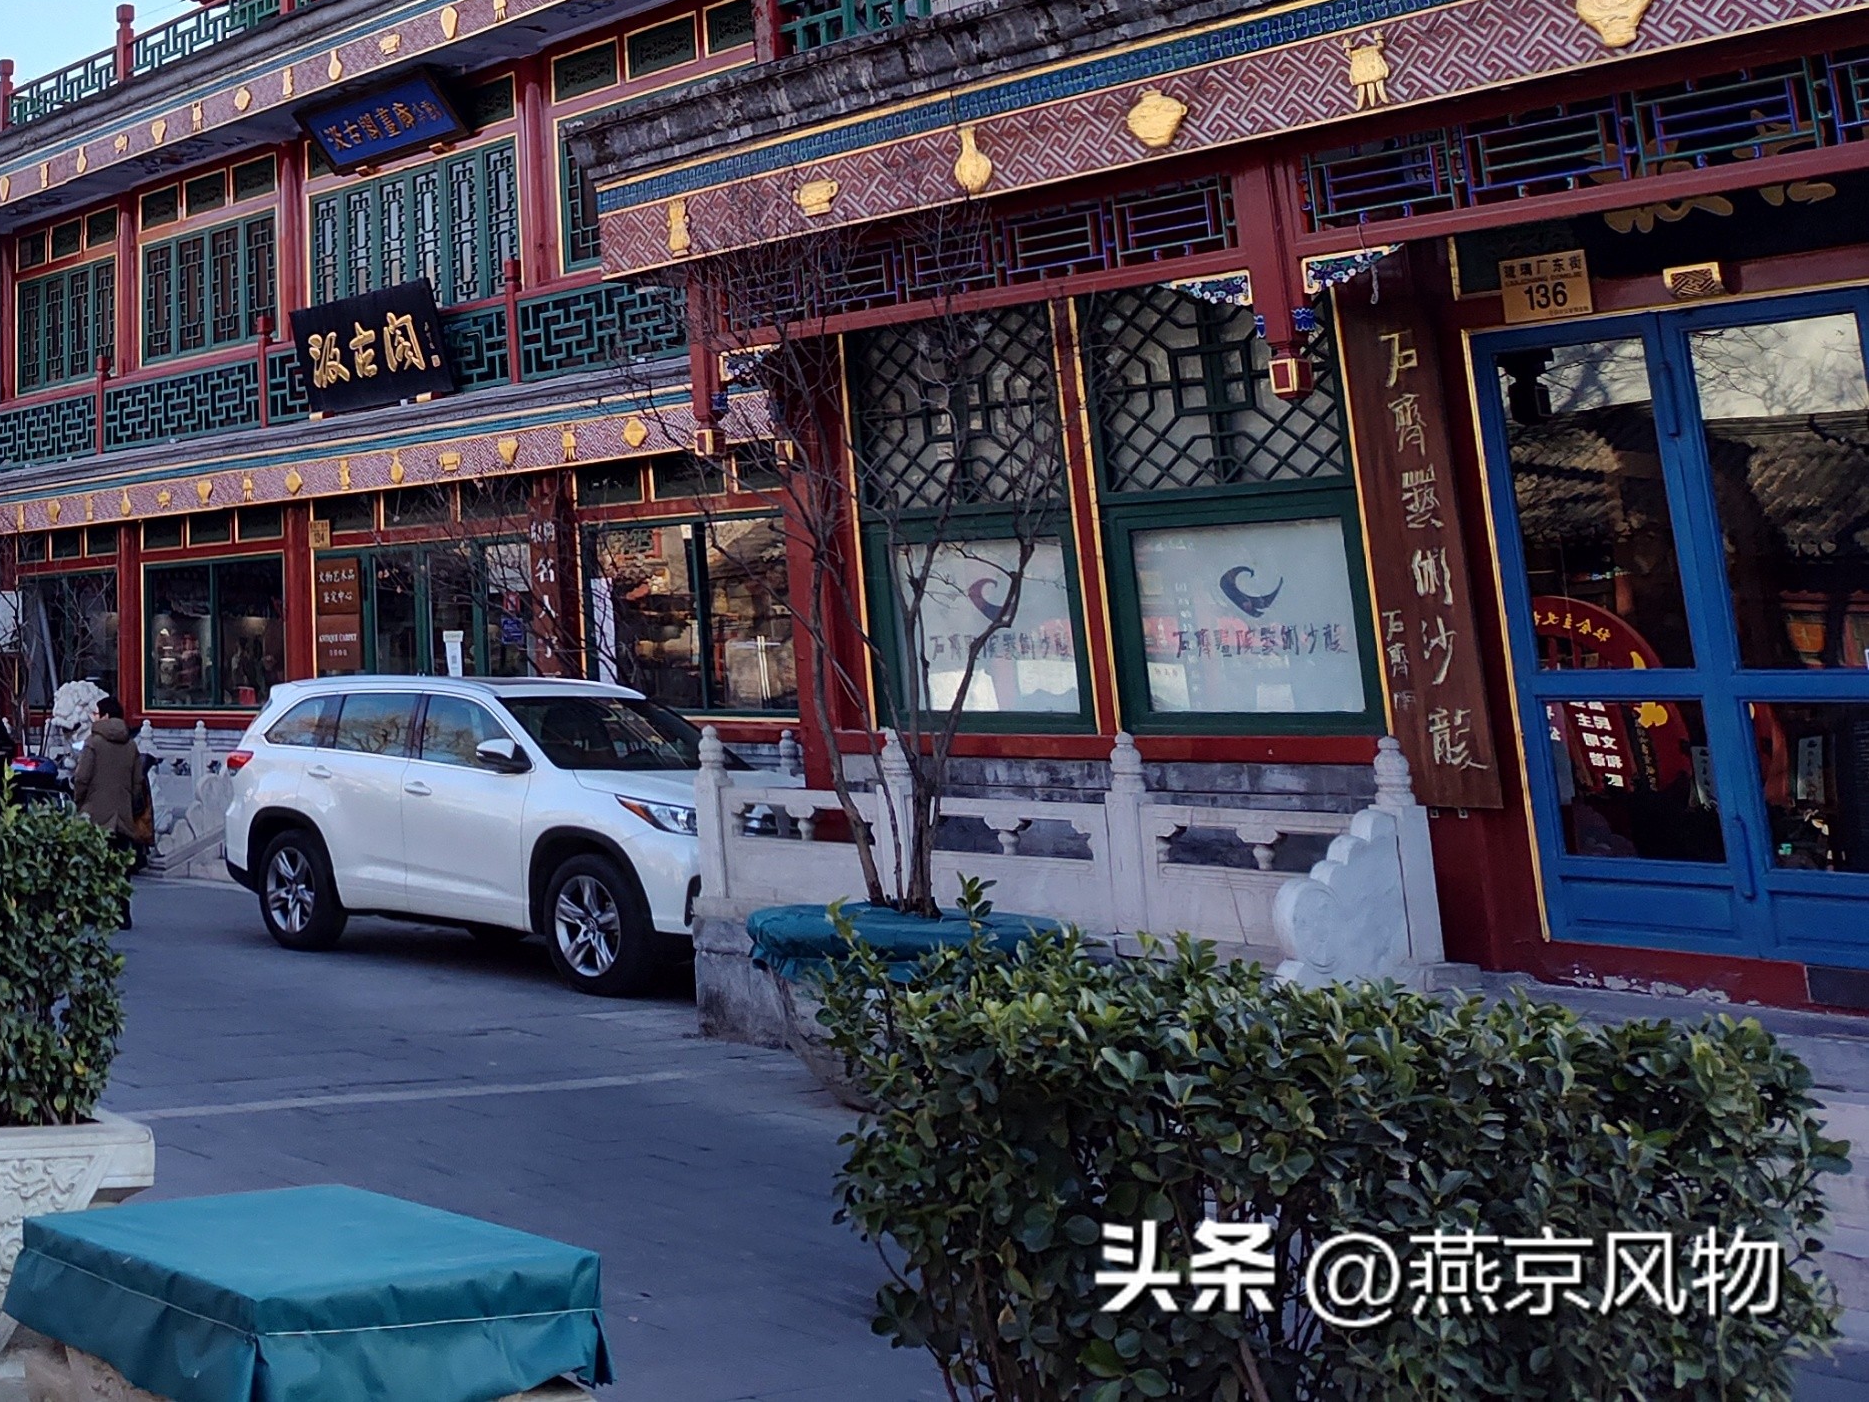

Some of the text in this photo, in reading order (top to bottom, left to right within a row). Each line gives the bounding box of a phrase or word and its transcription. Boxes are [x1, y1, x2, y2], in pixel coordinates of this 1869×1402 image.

[1504, 255, 1582, 279] 琉璃厂东街
[1524, 282, 1568, 311] 136
[319, 569, 355, 584] 文物艺术品
